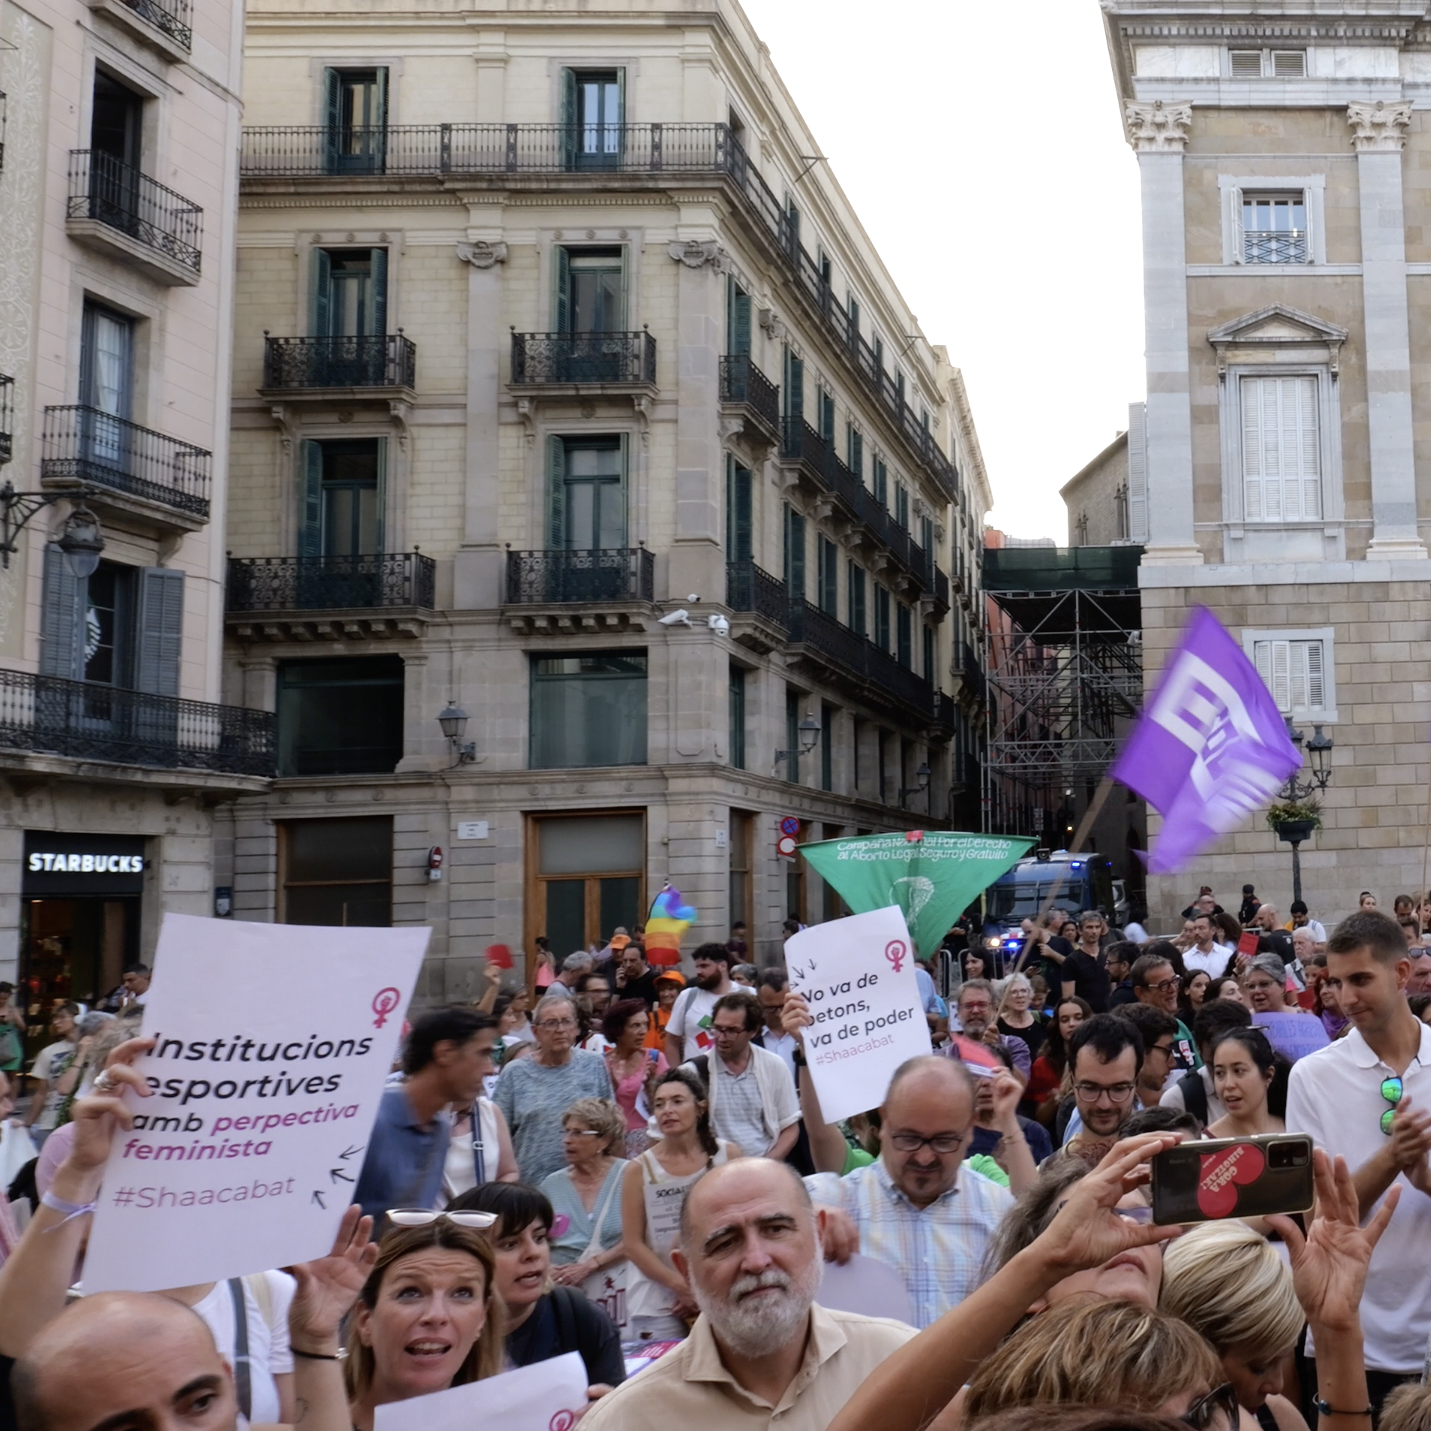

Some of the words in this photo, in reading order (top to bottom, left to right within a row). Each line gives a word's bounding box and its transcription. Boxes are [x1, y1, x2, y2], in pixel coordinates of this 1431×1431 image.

[837, 837, 892, 852] Campaña
[967, 837, 1012, 850] Derecho
[837, 851, 848, 860] al
[850, 850, 890, 861] Aborto
[892, 848, 919, 862] Legal
[919, 847, 958, 862] Seguro
[958, 850, 966, 862] y
[965, 849, 1009, 860] Gratuito
[29, 852, 143, 873] STARBUCKS
[801, 988, 825, 1004] No
[829, 981, 851, 996] va
[857, 972, 879, 989] de
[810, 1033, 833, 1049] va
[837, 1024, 860, 1041] de
[864, 1007, 915, 1036] poder
[146, 1032, 374, 1062] Institucions
[815, 1033, 895, 1066] #Shaacabat
[145, 1070, 343, 1105] esportives
[132, 1112, 204, 1133] amb
[209, 1102, 360, 1136] perpectiva
[122, 1138, 273, 1161] feminista
[112, 1176, 296, 1209] #Shaacabat
